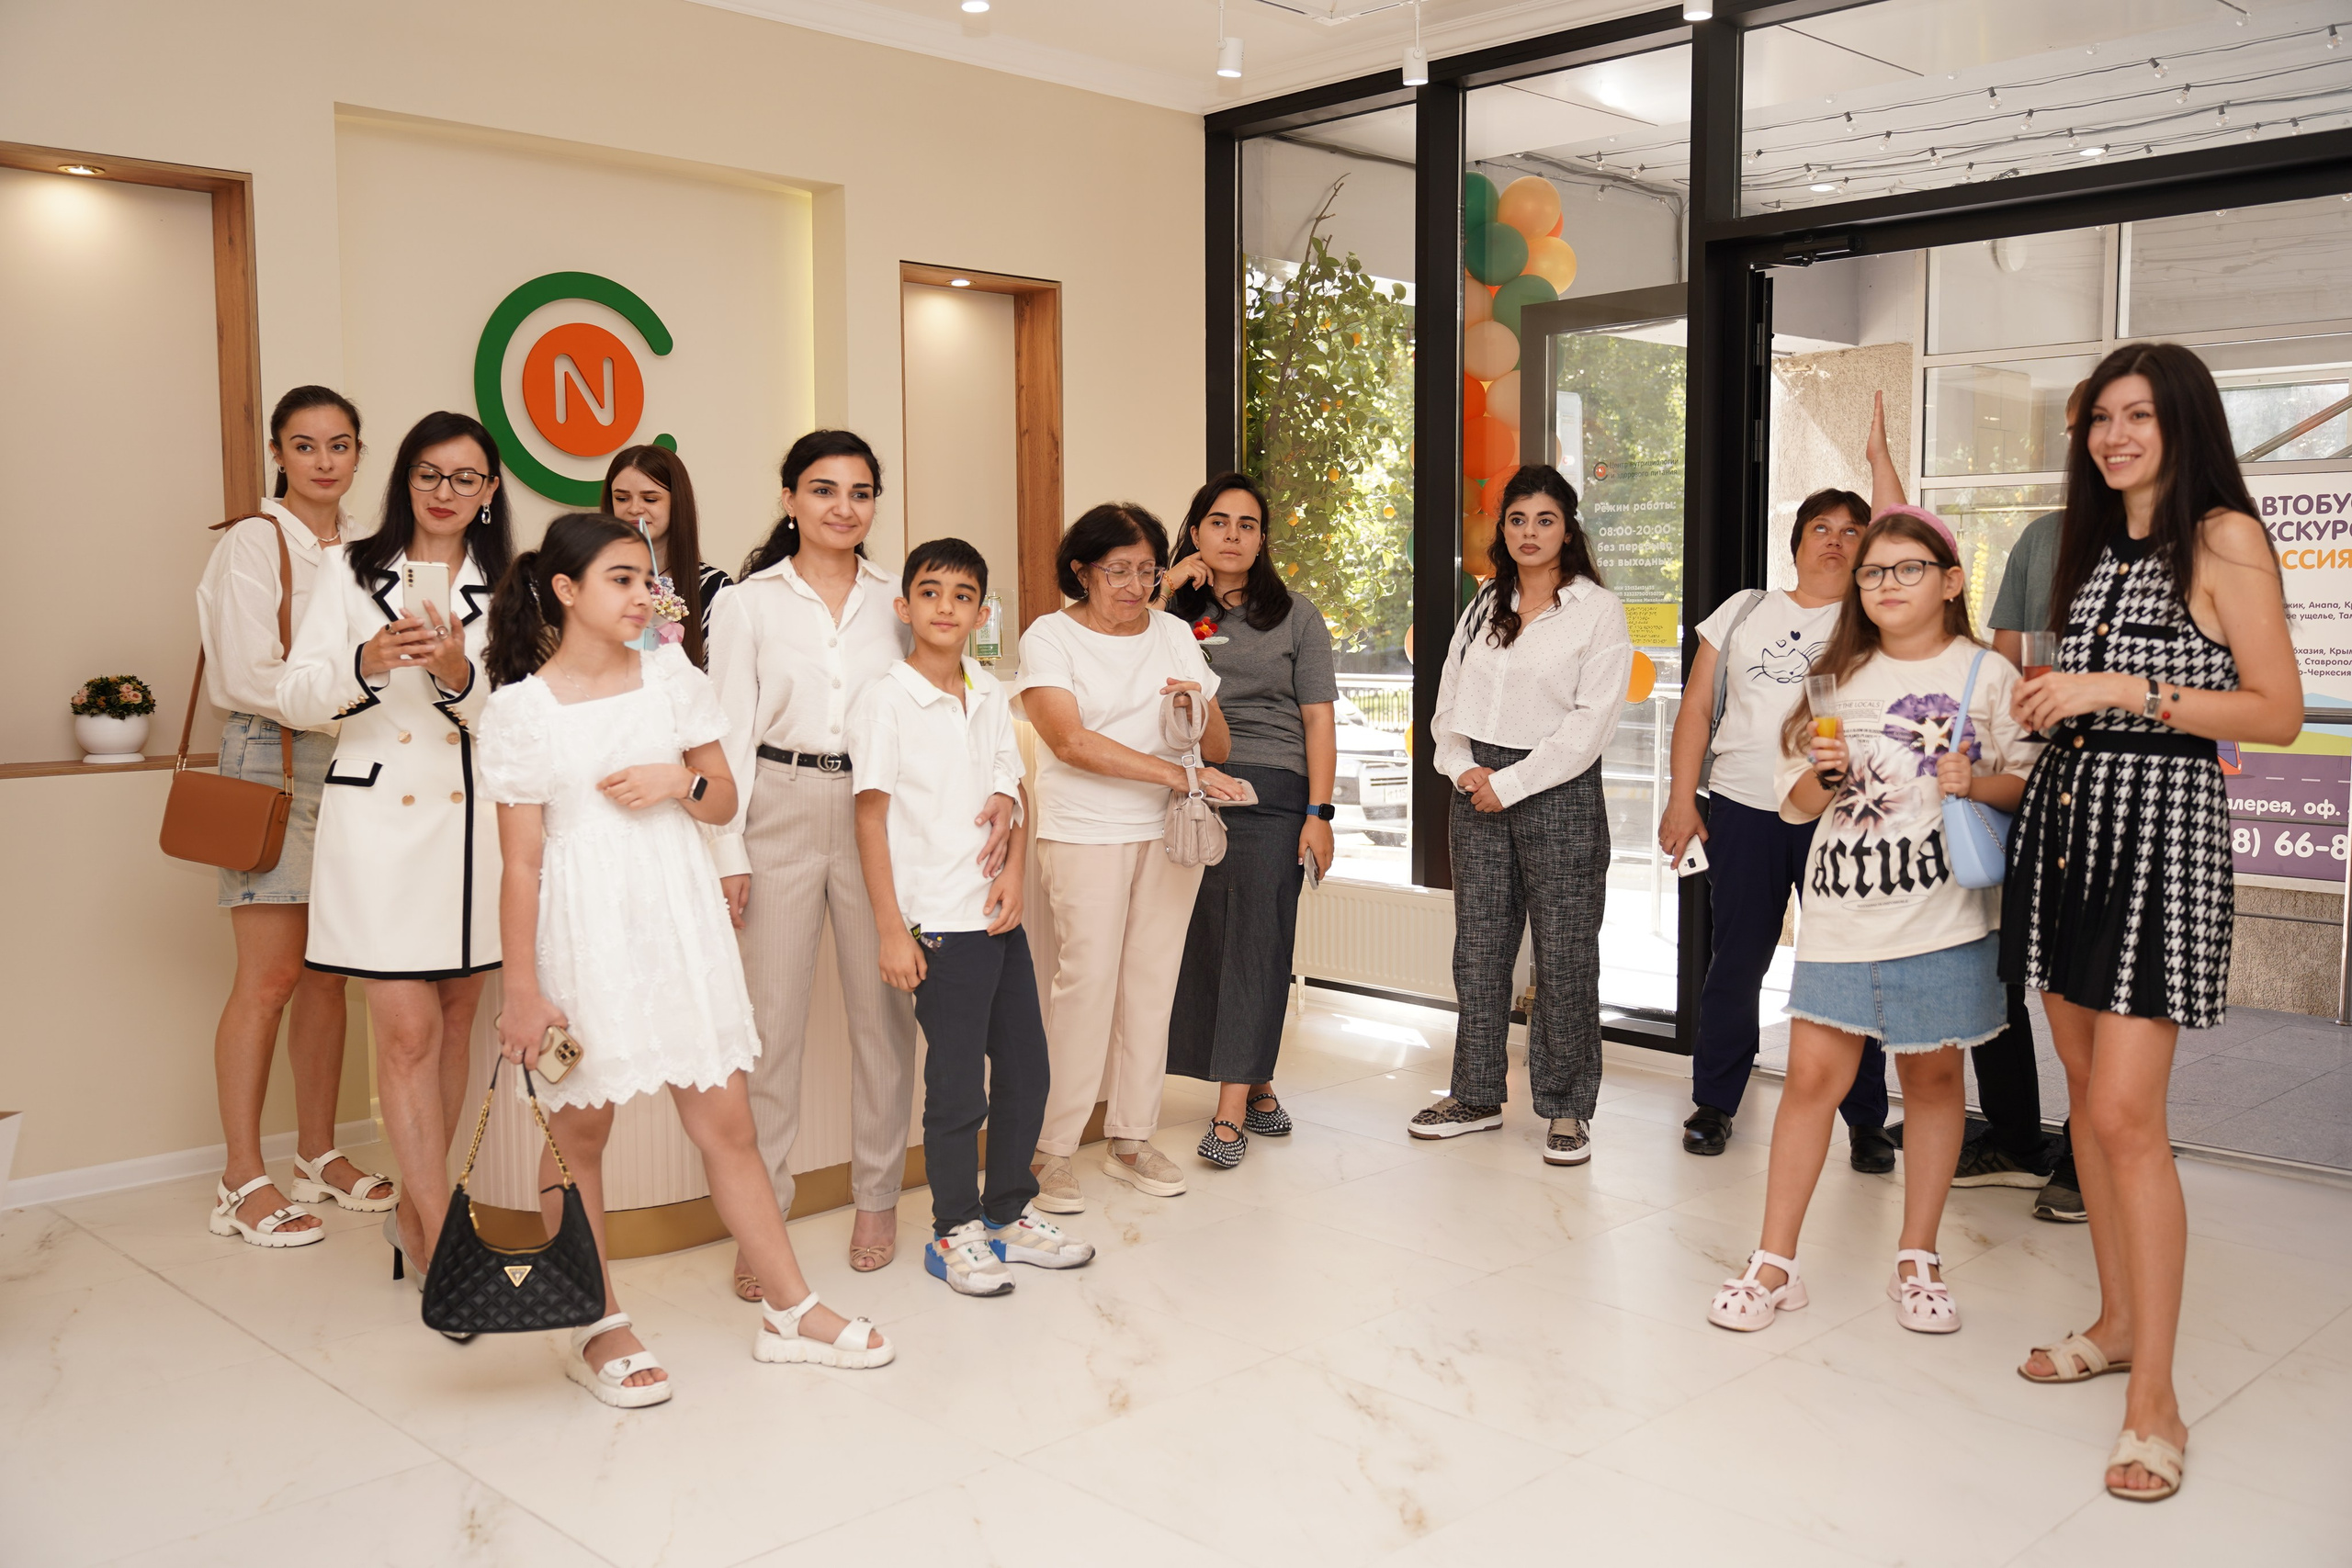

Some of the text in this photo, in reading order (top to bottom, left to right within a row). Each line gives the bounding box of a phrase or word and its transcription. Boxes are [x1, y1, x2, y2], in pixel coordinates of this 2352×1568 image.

[554, 354, 615, 426] N
[1594, 501, 1677, 513] Режим работы:
[2251, 492, 2352, 516] ВТОБУ
[1599, 524, 1671, 537] 08:00-20:00
[2263, 520, 2352, 542] КСКУР
[1597, 541, 1673, 553] без перерыва
[1596, 557, 1673, 567] без выходных
[2275, 548, 2352, 570] ССИЯ
[2303, 798, 2341, 819] оф.
